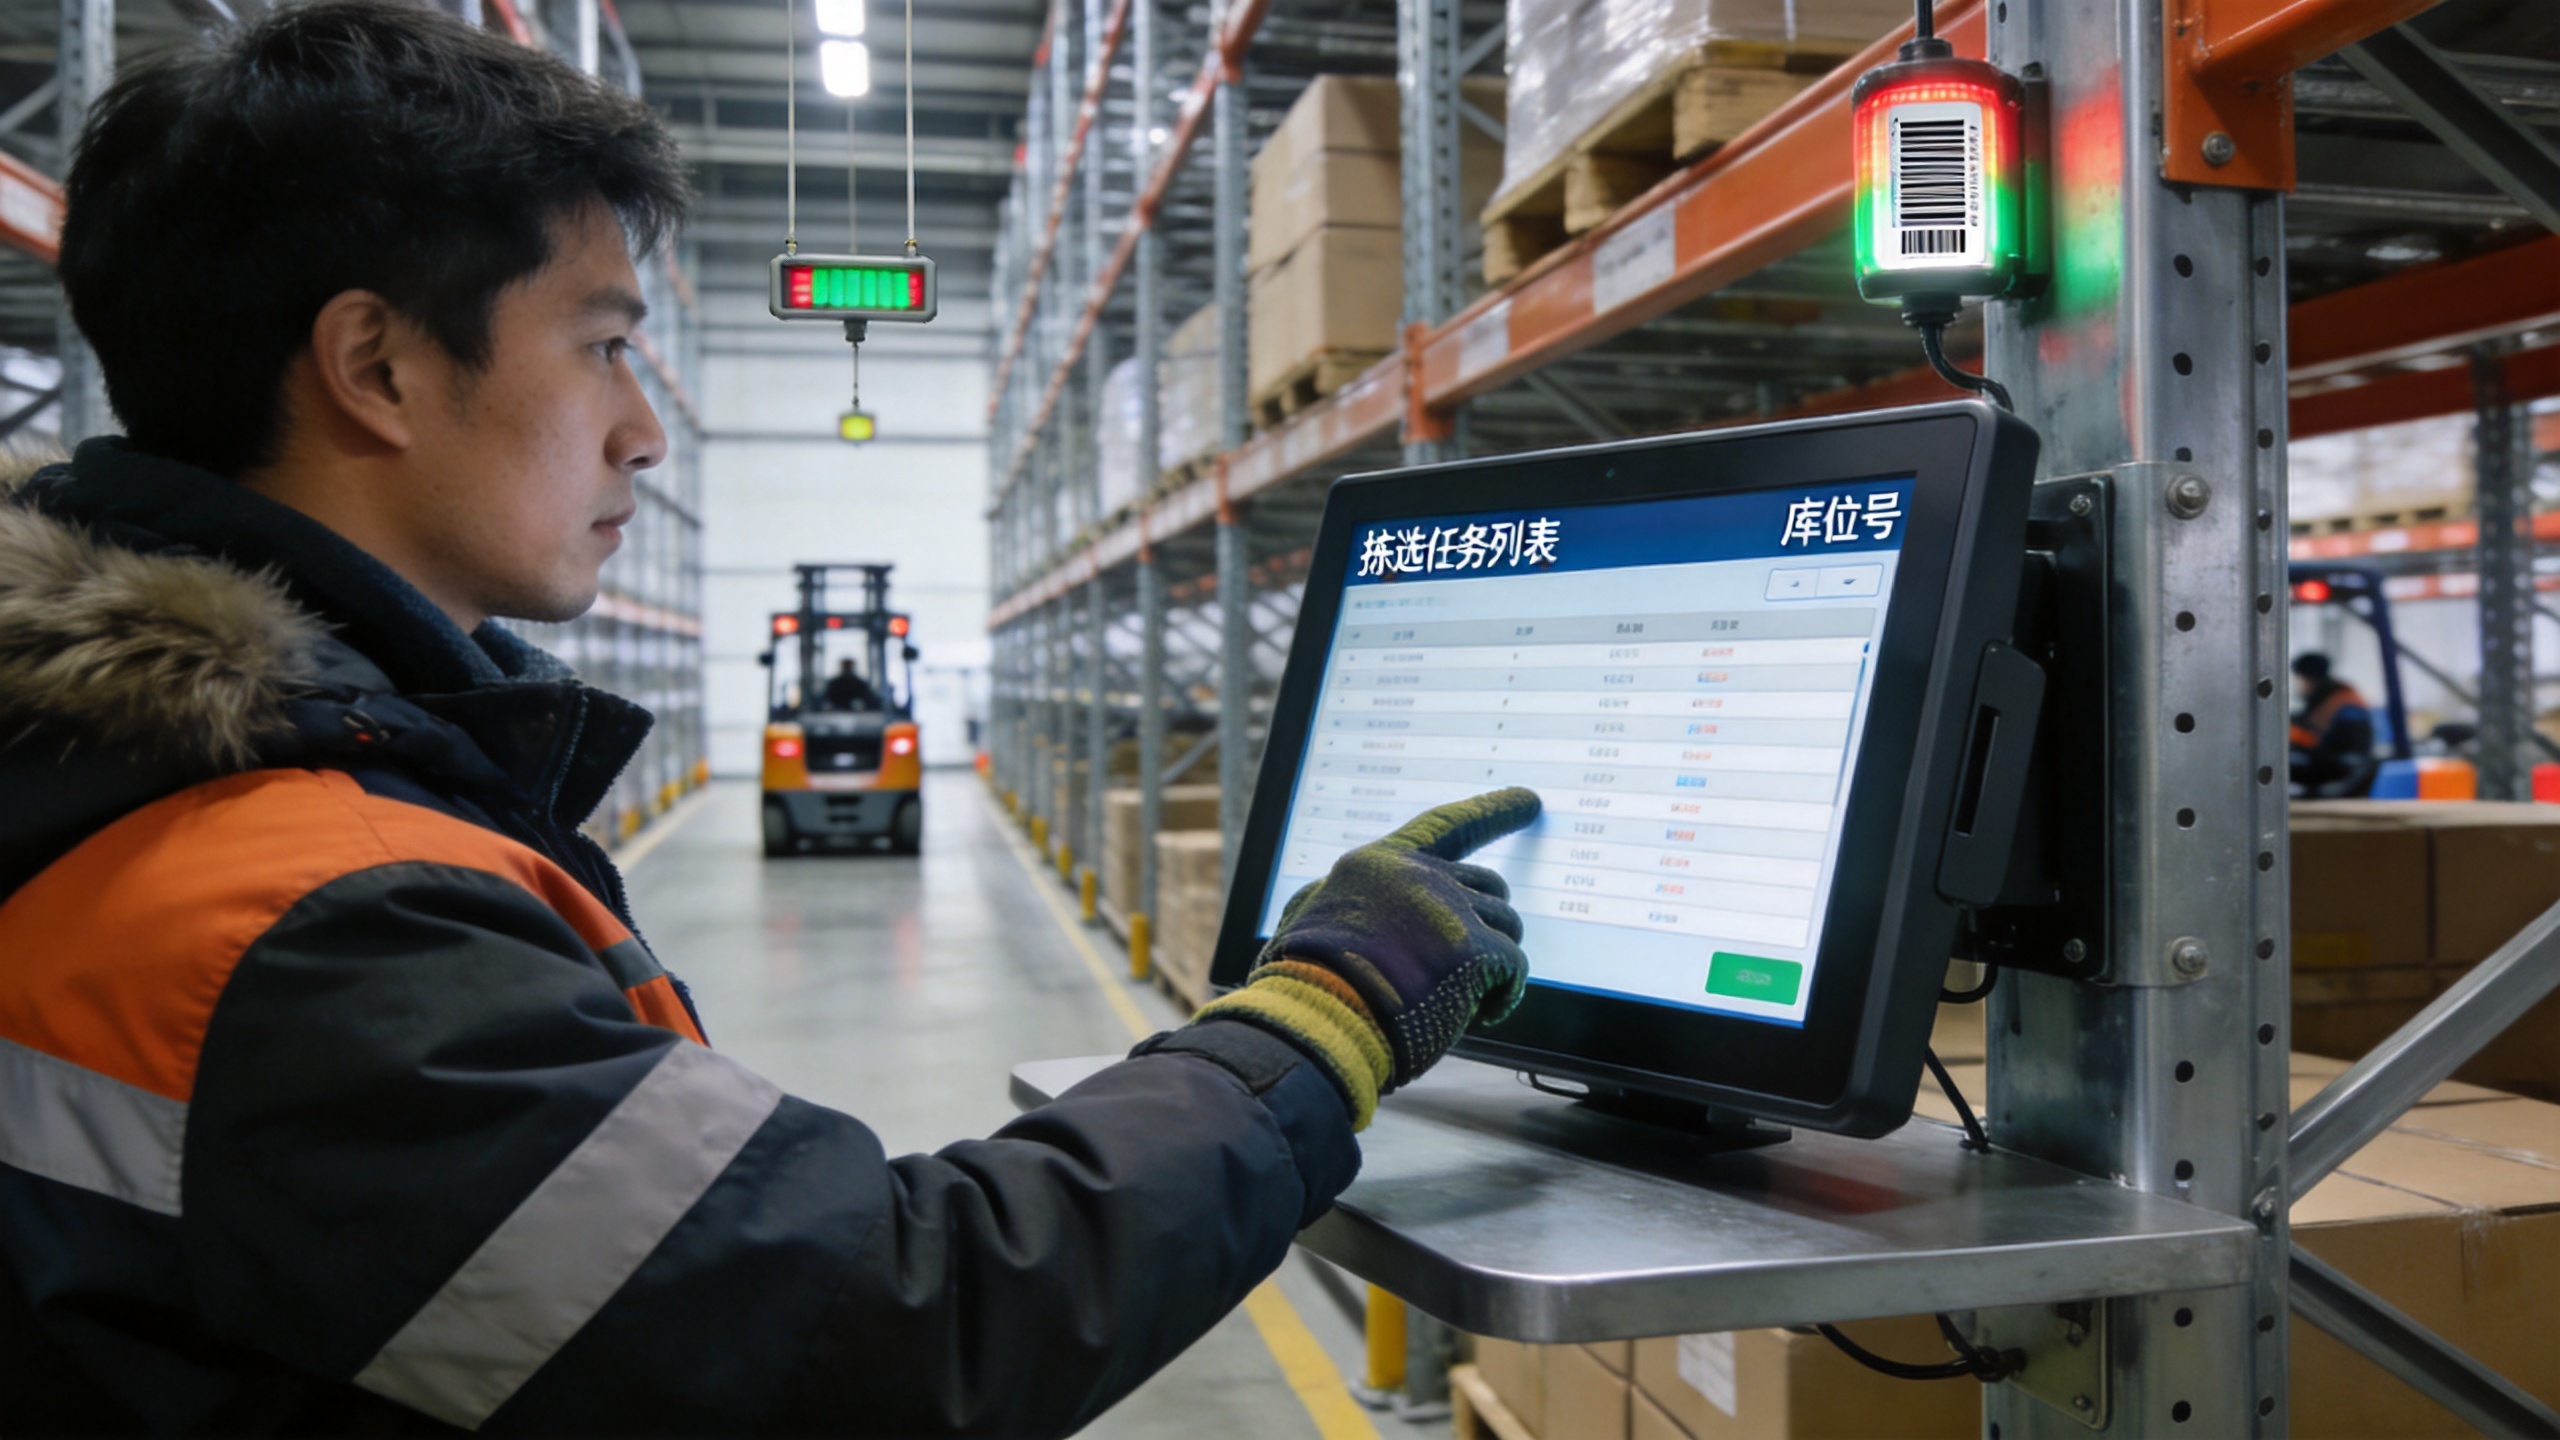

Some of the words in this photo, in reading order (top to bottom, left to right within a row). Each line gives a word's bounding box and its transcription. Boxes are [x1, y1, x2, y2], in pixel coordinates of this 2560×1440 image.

[1357, 517, 1561, 577] 拣选任务列表
[1781, 492, 1902, 547] 库位号
